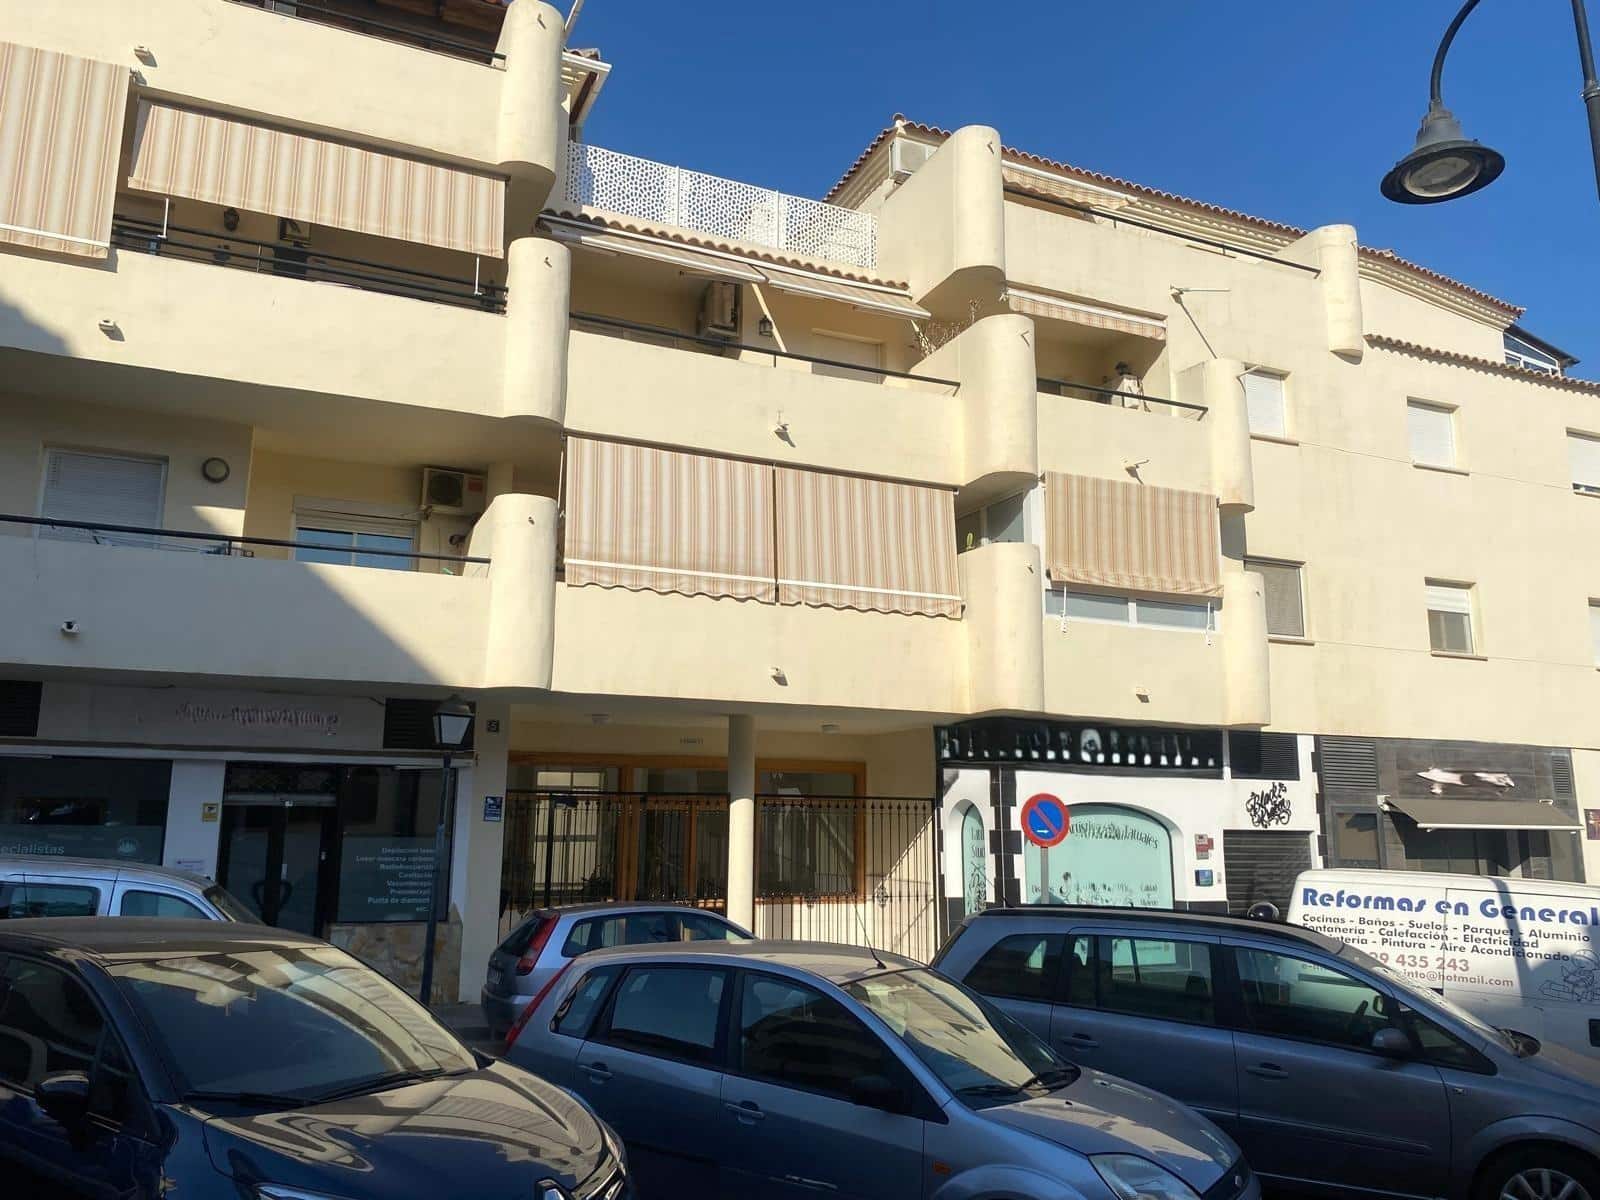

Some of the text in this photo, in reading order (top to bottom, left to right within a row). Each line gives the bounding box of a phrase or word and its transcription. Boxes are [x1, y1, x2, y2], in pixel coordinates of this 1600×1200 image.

[1302, 887, 1600, 926] Reformas en General
[1302, 913, 1346, 924] Cocinas
[1358, 916, 1395, 927] Baños
[1408, 920, 1449, 931] Suelos
[1463, 924, 1515, 937] Parquet
[1528, 929, 1590, 942] Aluminio
[1378, 928, 1449, 941] Calefacción
[1463, 934, 1540, 949] Electricidad
[1381, 937, 1426, 949] Pintura
[1440, 942, 1466, 953] Aire
[1470, 944, 1570, 961] Acondicionado
[1395, 953, 1429, 969] 435
[1435, 956, 1470, 972] 243
